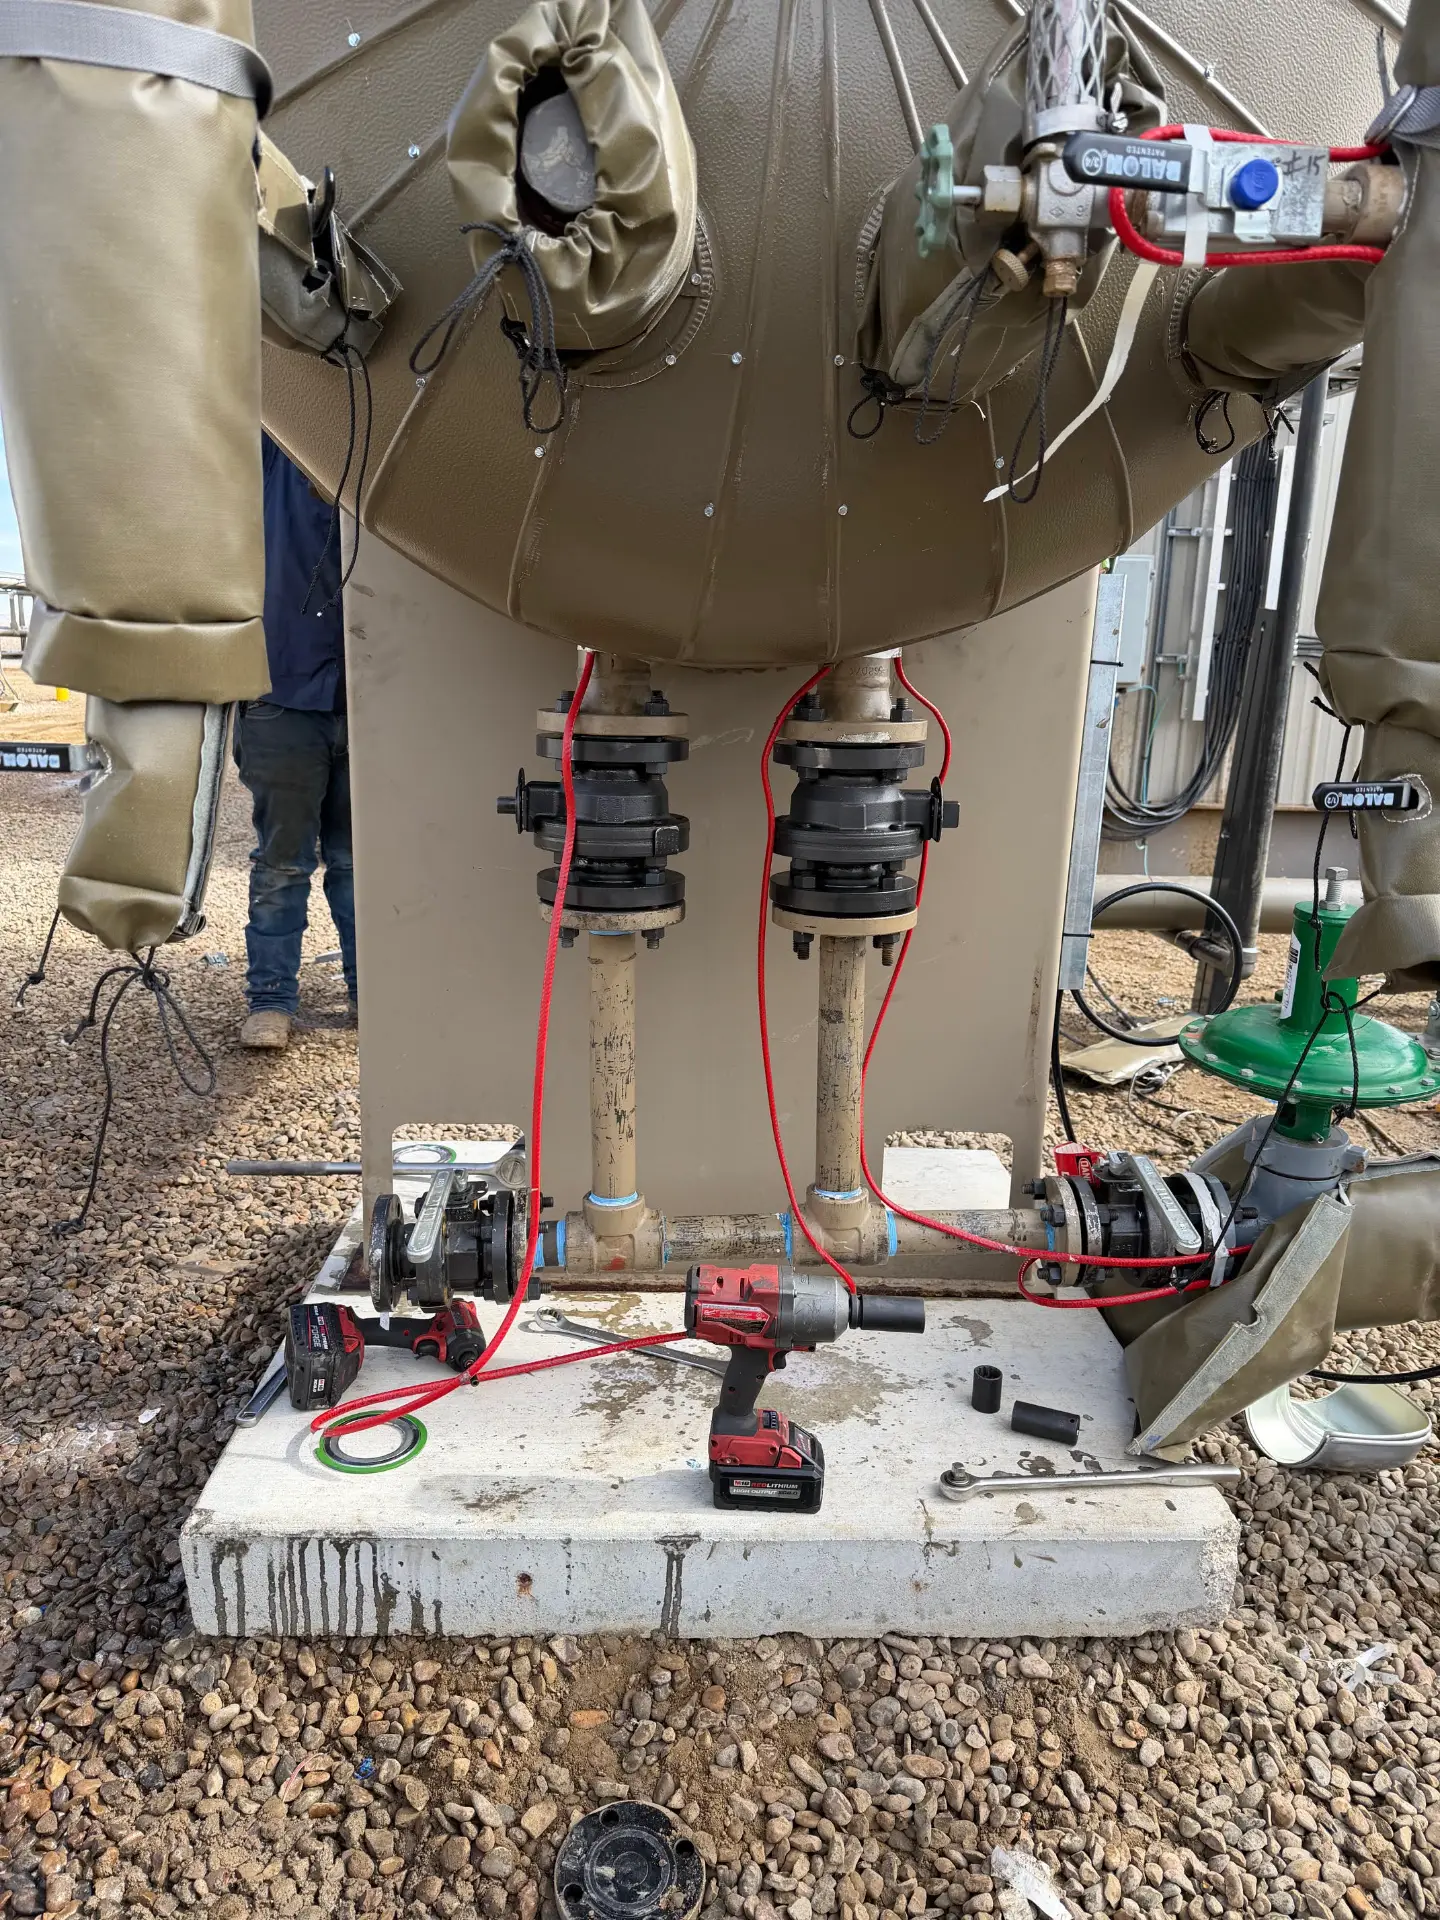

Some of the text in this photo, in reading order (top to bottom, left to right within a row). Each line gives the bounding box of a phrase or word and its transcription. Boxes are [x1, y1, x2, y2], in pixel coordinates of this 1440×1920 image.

[1126, 145, 1166, 157] PATENTED
[1085, 154, 1182, 182] BALON 3/4
[1341, 792, 1394, 806] BALON
[311, 1325, 321, 1347] FORGE
